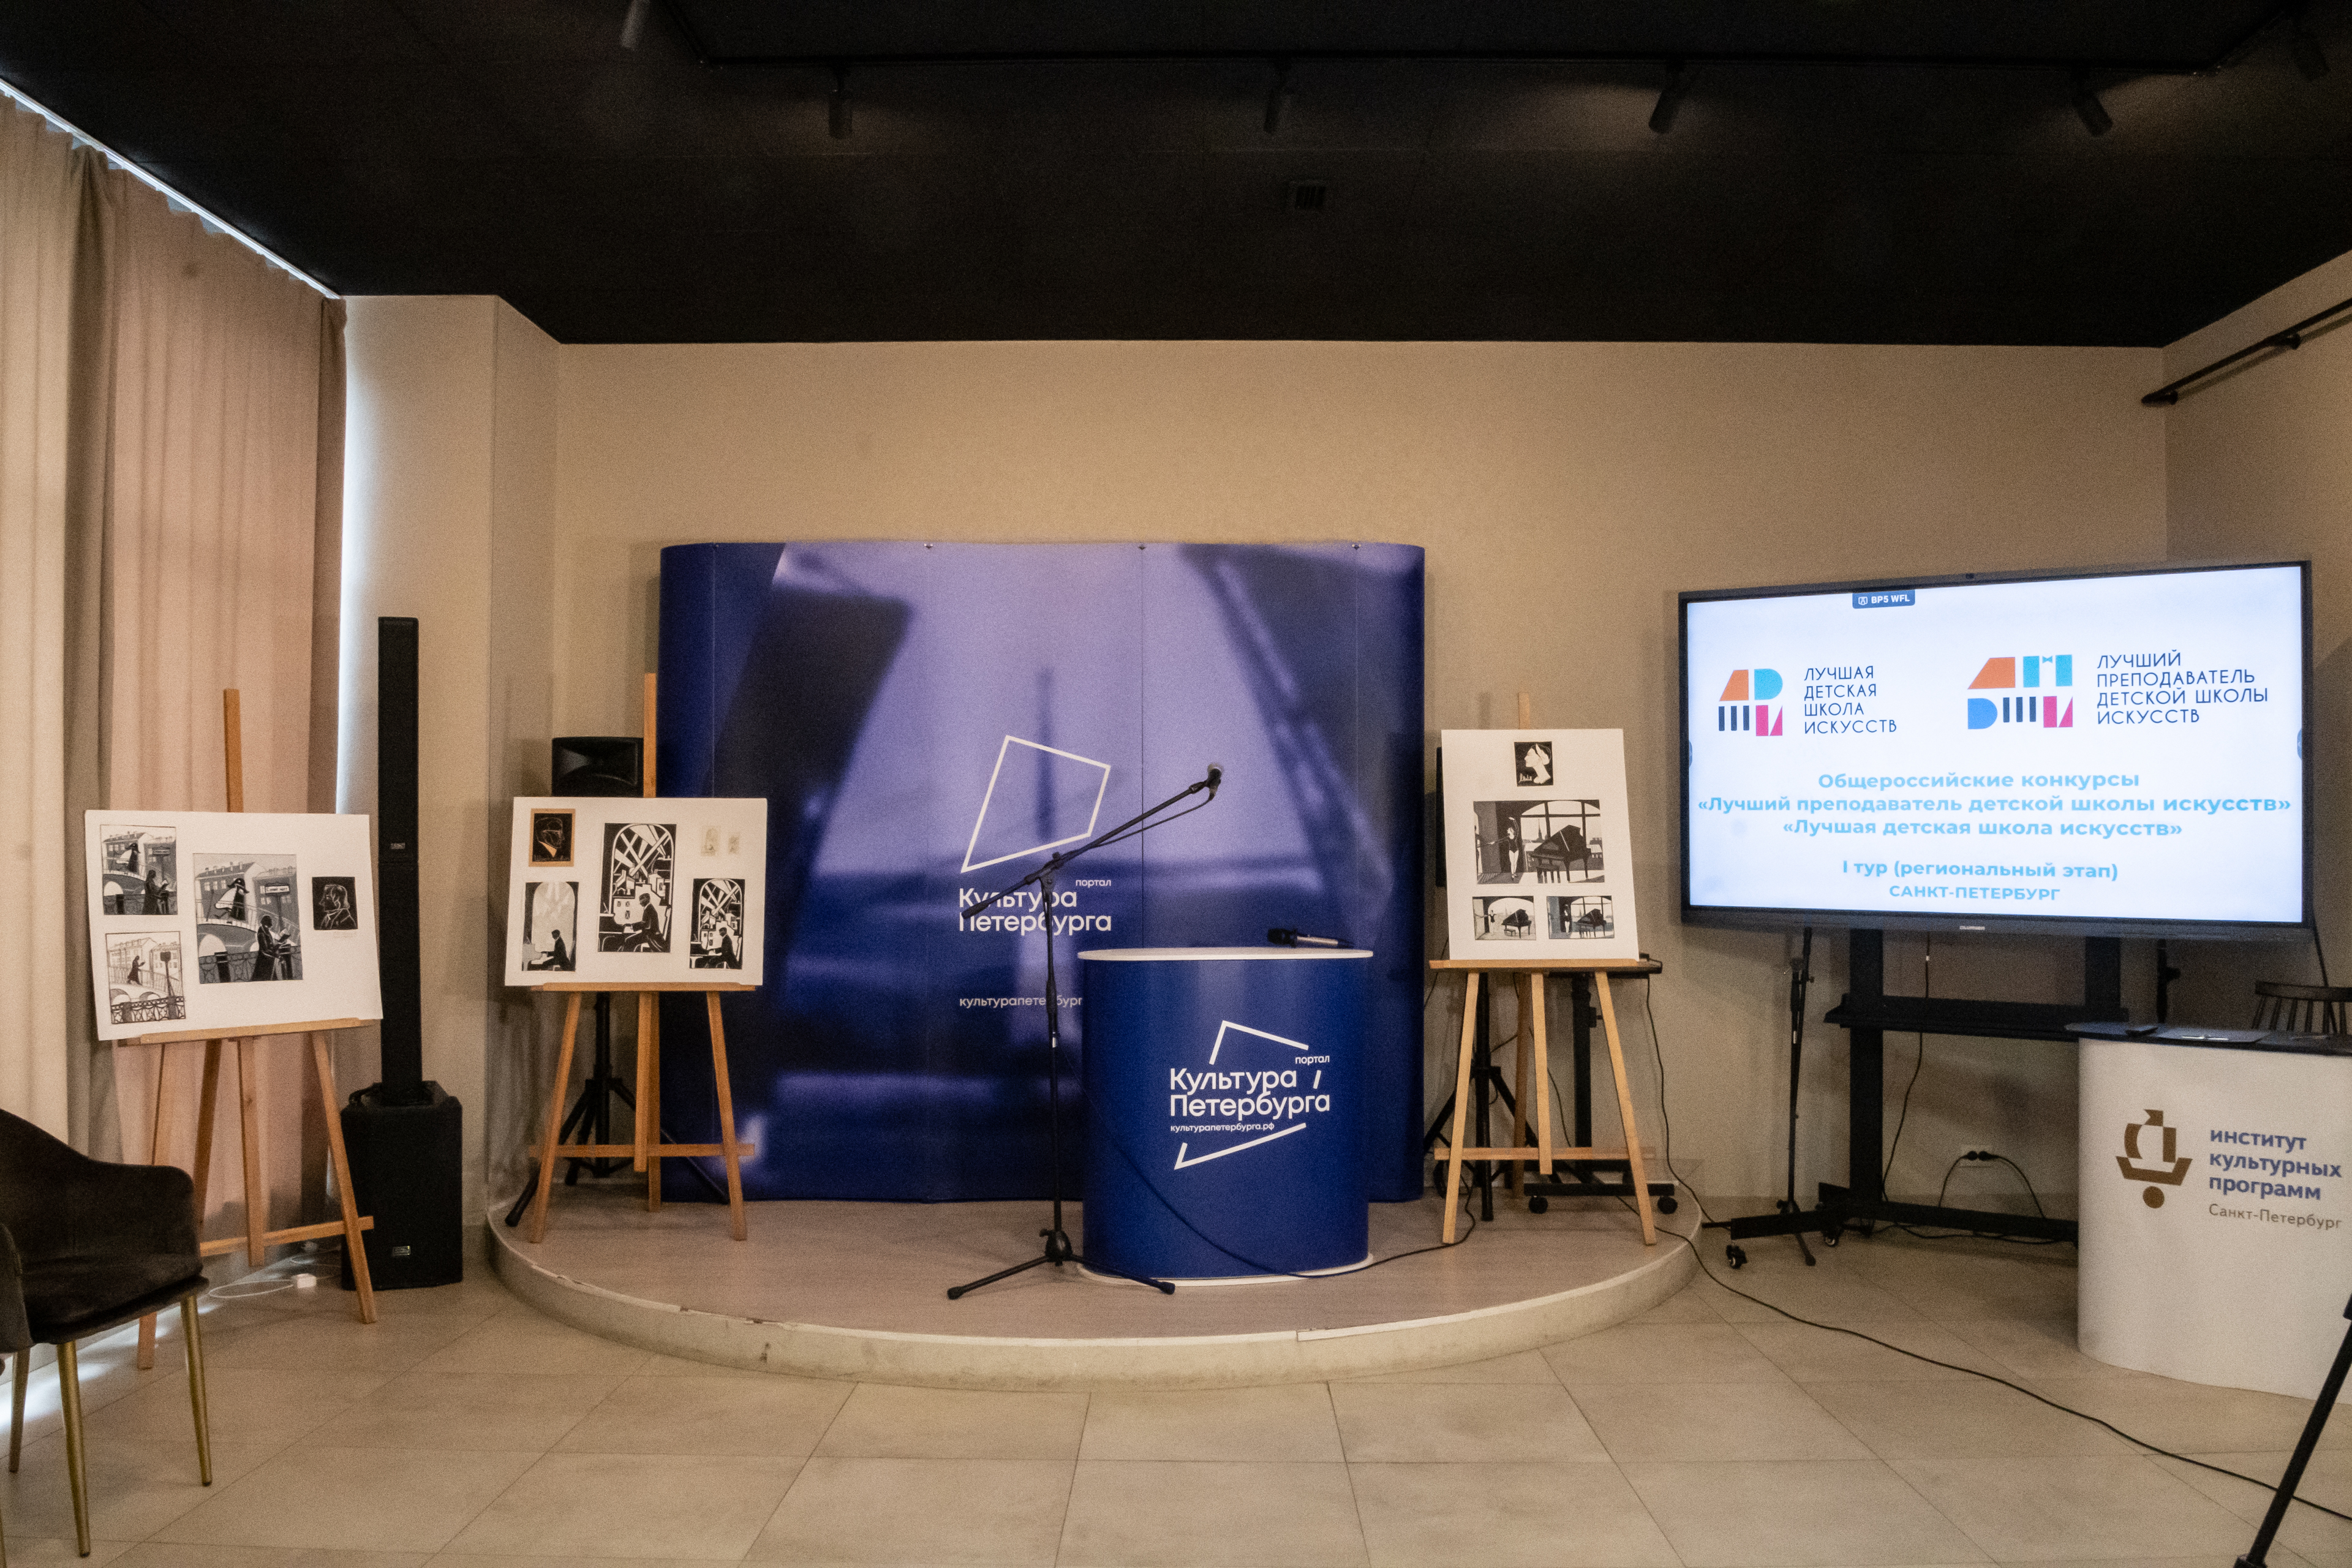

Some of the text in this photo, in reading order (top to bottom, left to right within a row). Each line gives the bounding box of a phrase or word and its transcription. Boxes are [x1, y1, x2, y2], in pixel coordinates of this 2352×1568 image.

[1891, 594, 1910, 603] WFL
[2097, 649, 2181, 669] ЛУЧШИЙ
[1804, 665, 1874, 681] ЛУЧШАЯ
[2097, 669, 2255, 688] ПРЕПОДАВАТЕЛЬ
[1804, 684, 1877, 701] ДЕТСКАЯ
[2097, 687, 2268, 708] ДЕТСКОЙ ШКОЛЫ
[1804, 703, 1864, 717] ШКОЛА
[2097, 708, 2200, 725] ИСКУССТВ
[1804, 719, 1897, 734] ИСКУССТВ
[1818, 772, 2139, 791] Общероссийские конкурсы
[1698, 796, 2291, 815] «Лучший преподаватель детской школы искусств»
[1783, 820, 2183, 840] «Лучшая детская школа искусств»
[1853, 863, 1888, 877] тур
[1894, 860, 2056, 878] (региональный
[2062, 863, 2119, 882] этап)
[1075, 879, 1112, 888] портал
[1889, 886, 2060, 901] САНКТ-ПЕТЕРБУРГ
[960, 995, 1083, 1009] культурапетебург
[1295, 1055, 1330, 1066] портал
[1170, 1068, 1297, 1096] Культура
[1170, 1091, 1330, 1121] Петербурга
[1170, 1122, 1275, 1133] культурапетербурга.рф
[2210, 1129, 2307, 1154] институт
[2209, 1153, 2342, 1178] культурных
[2209, 1177, 2321, 1200] программ
[2209, 1203, 2342, 1231] Санкт-Петербург
